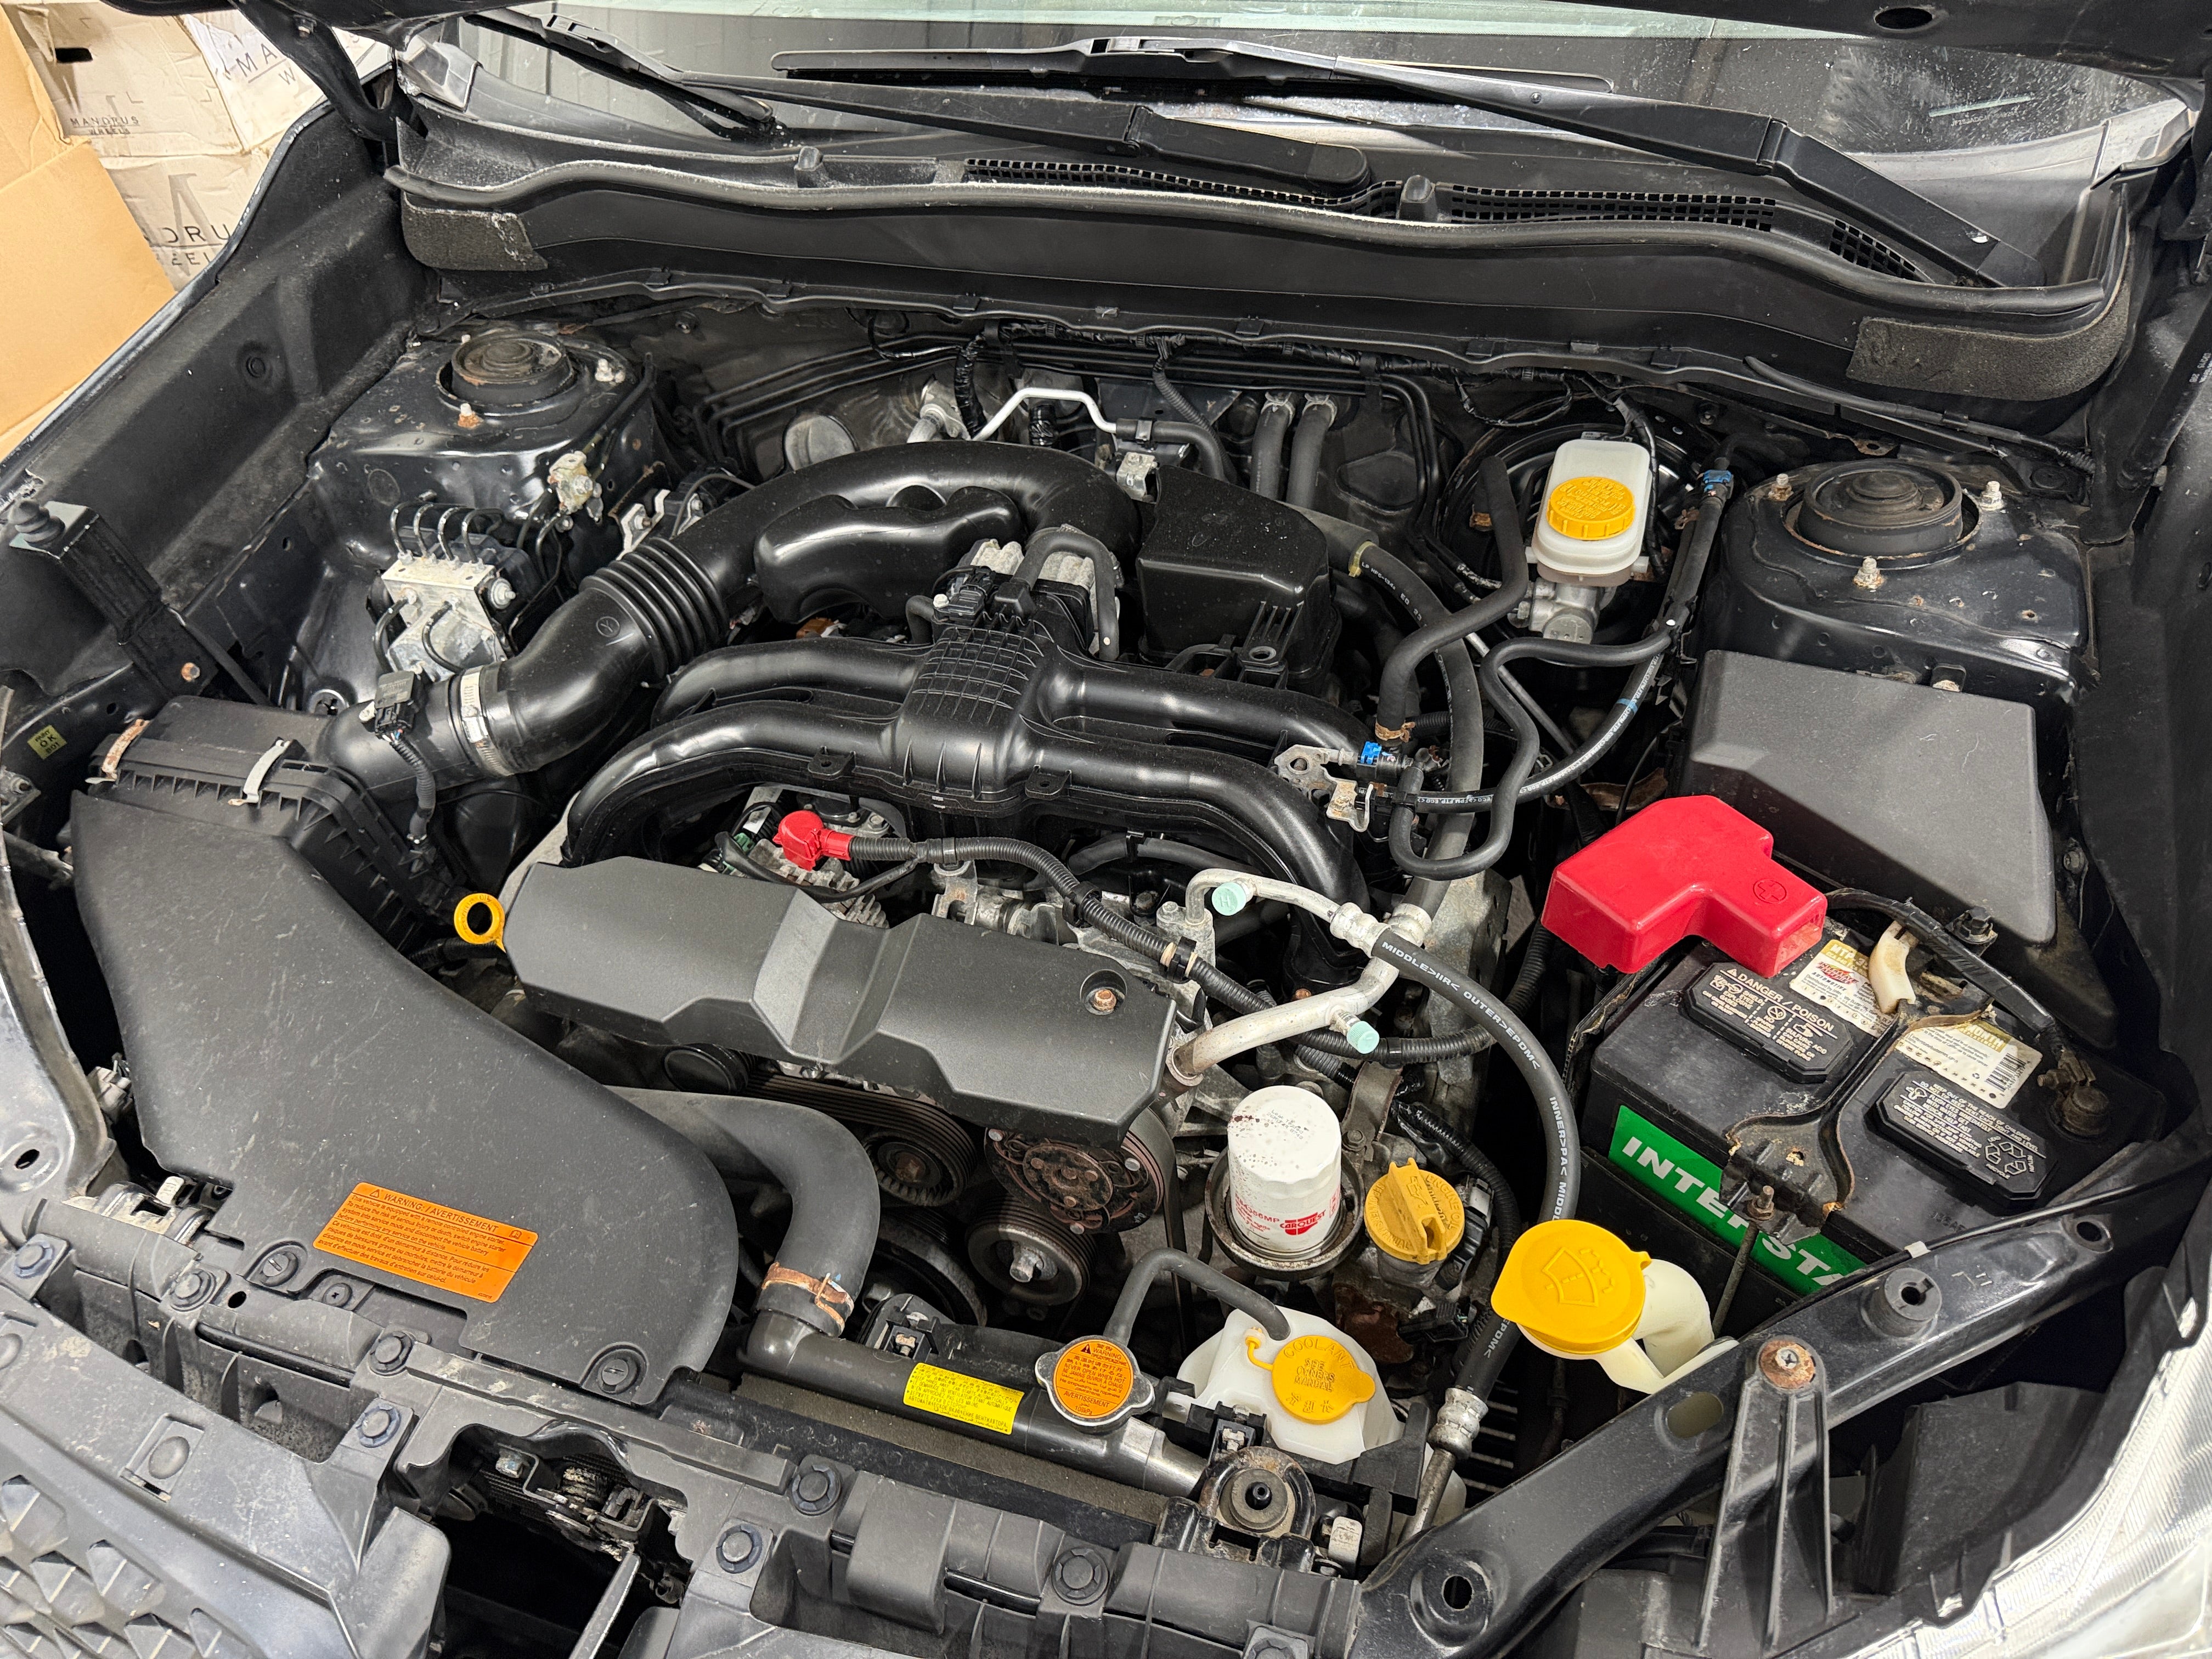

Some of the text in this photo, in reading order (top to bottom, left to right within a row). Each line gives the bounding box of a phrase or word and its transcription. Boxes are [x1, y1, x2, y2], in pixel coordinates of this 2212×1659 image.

[1736, 972, 1785, 1003] DANGER
[1790, 1003, 1836, 1032] POISON
[1739, 994, 1755, 1005] EYES
[1741, 990, 1764, 1005] SHIELD
[1763, 1015, 1775, 1024] NO
[1784, 1027, 1828, 1055] SULFURIC ACID
[1426, 1174, 1460, 1210] ENGINE
[1449, 1212, 1461, 1231] OIL
[382, 1193, 426, 1211] WARNING:
[429, 1207, 499, 1232] AVERTISSEMENT
[1280, 1210, 1326, 1228] CARQUEST
[1093, 1347, 1122, 1360] WARNING
[1283, 1337, 1356, 1369] COOLANT
[1064, 1363, 1081, 1372] NEVER
[1082, 1368, 1096, 1376] OPEN
[1097, 1372, 1113, 1381] WHEN
[1305, 1357, 1326, 1369] SEE
[1069, 1370, 1085, 1378] JAMAIS
[1086, 1374, 1103, 1383] OUVRIR
[1296, 1365, 1335, 1383] OWNERS
[1294, 1375, 1334, 1392] MANUAL
[1063, 1390, 1110, 1408] AVERTISSEMENT
